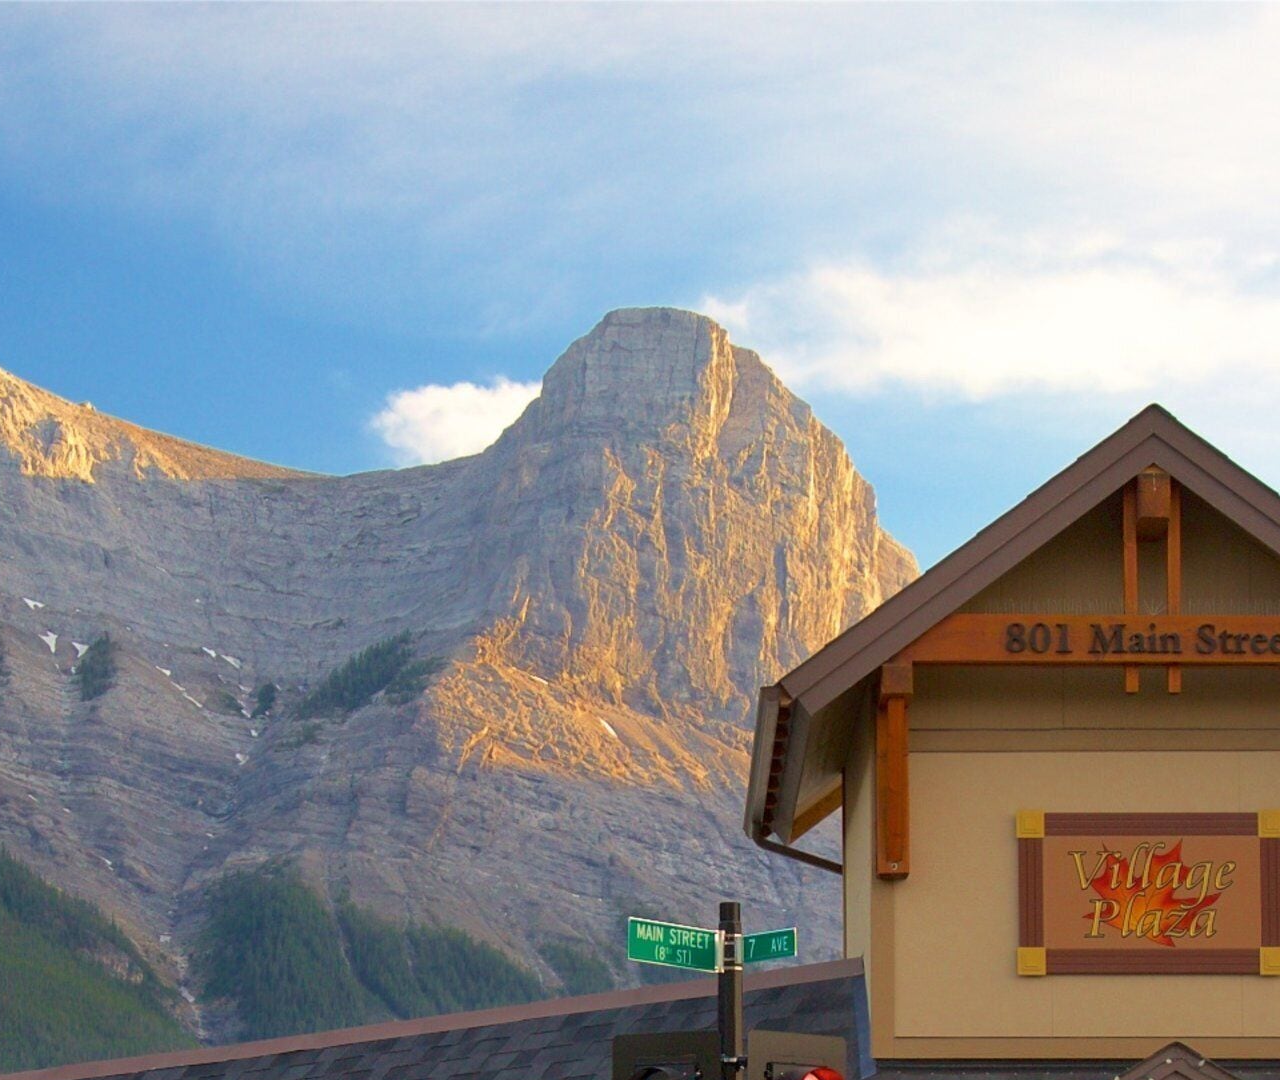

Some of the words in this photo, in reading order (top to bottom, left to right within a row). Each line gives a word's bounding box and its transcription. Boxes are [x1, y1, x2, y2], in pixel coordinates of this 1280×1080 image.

[1005, 623, 1073, 654] 801
[1087, 623, 1182, 655] Main
[1068, 841, 1237, 909] Village
[1083, 891, 1218, 939] Plaza
[636, 923, 664, 942] MAIN
[669, 928, 710, 950] STREET
[748, 938, 756, 959] 7
[770, 936, 789, 953] AVE
